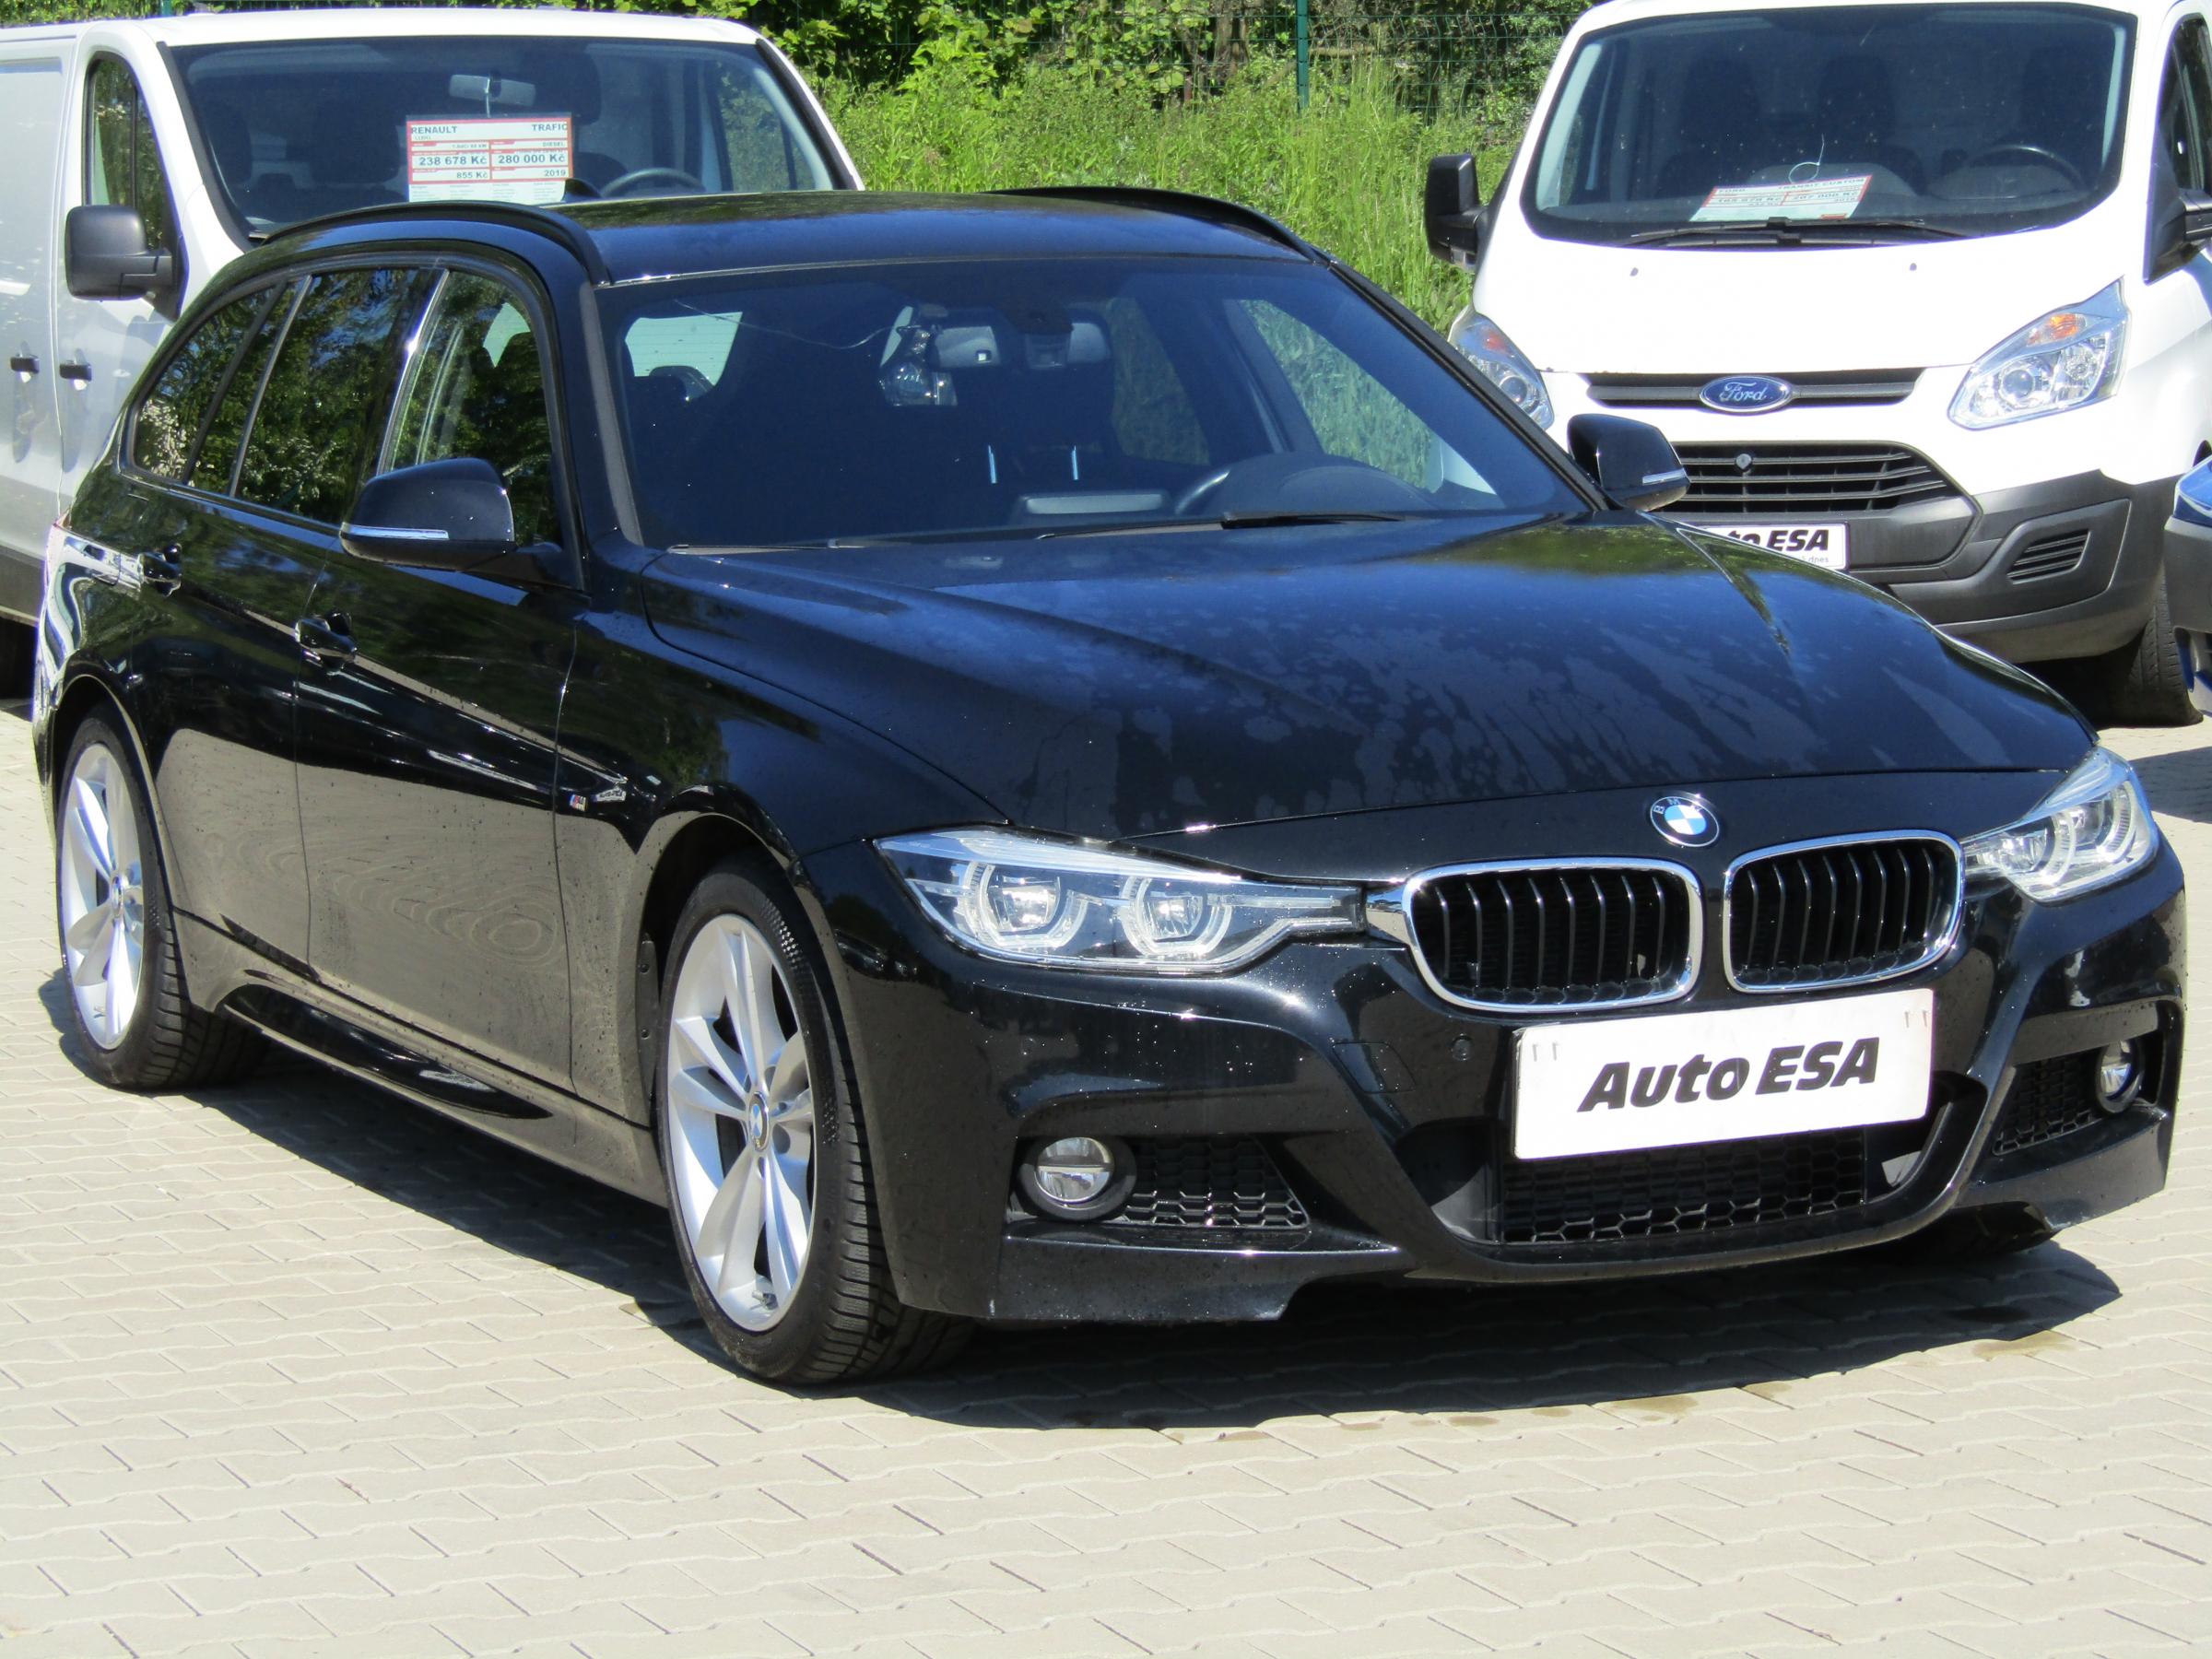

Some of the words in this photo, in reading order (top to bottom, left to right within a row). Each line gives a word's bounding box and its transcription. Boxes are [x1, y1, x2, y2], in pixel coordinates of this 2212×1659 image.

[411, 125, 457, 135] RENAULT
[531, 123, 568, 132] TRAFIC
[419, 157, 441, 166] 238
[445, 156, 466, 165] 678
[471, 155, 488, 164] Kč
[498, 154, 520, 164] 280
[524, 154, 546, 163] 000
[549, 153, 566, 162] Kč
[544, 169, 566, 177] 2019
[1720, 382, 1769, 402] Ford
[1766, 529, 1830, 552] ESA
[1576, 1053, 1750, 1113] Auto
[1755, 1037, 1880, 1096] ESA
